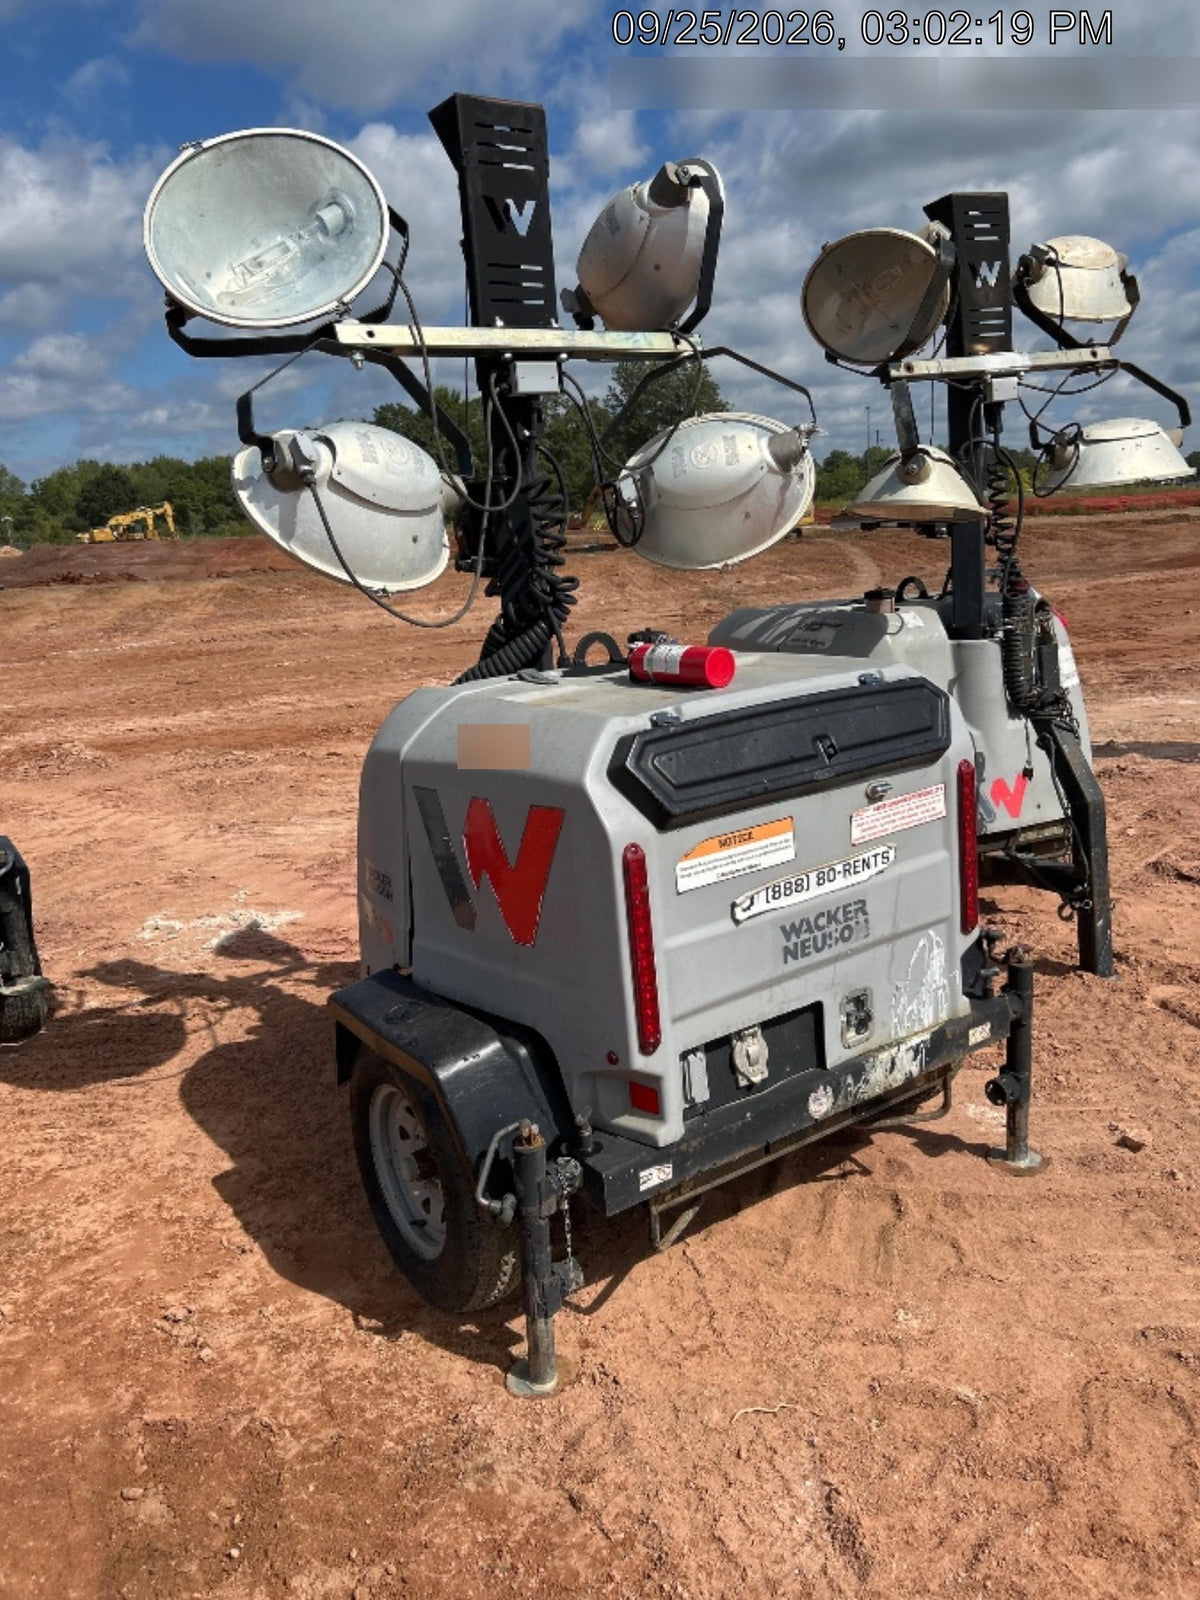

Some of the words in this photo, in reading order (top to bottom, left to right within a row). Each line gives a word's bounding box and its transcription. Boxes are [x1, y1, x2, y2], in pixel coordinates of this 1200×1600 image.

[718, 831, 755, 849] NOTICE
[412, 785, 566, 948] W
[765, 873, 810, 904] (888)
[815, 850, 890, 887] 80-RENTS
[779, 898, 869, 943] WACKER
